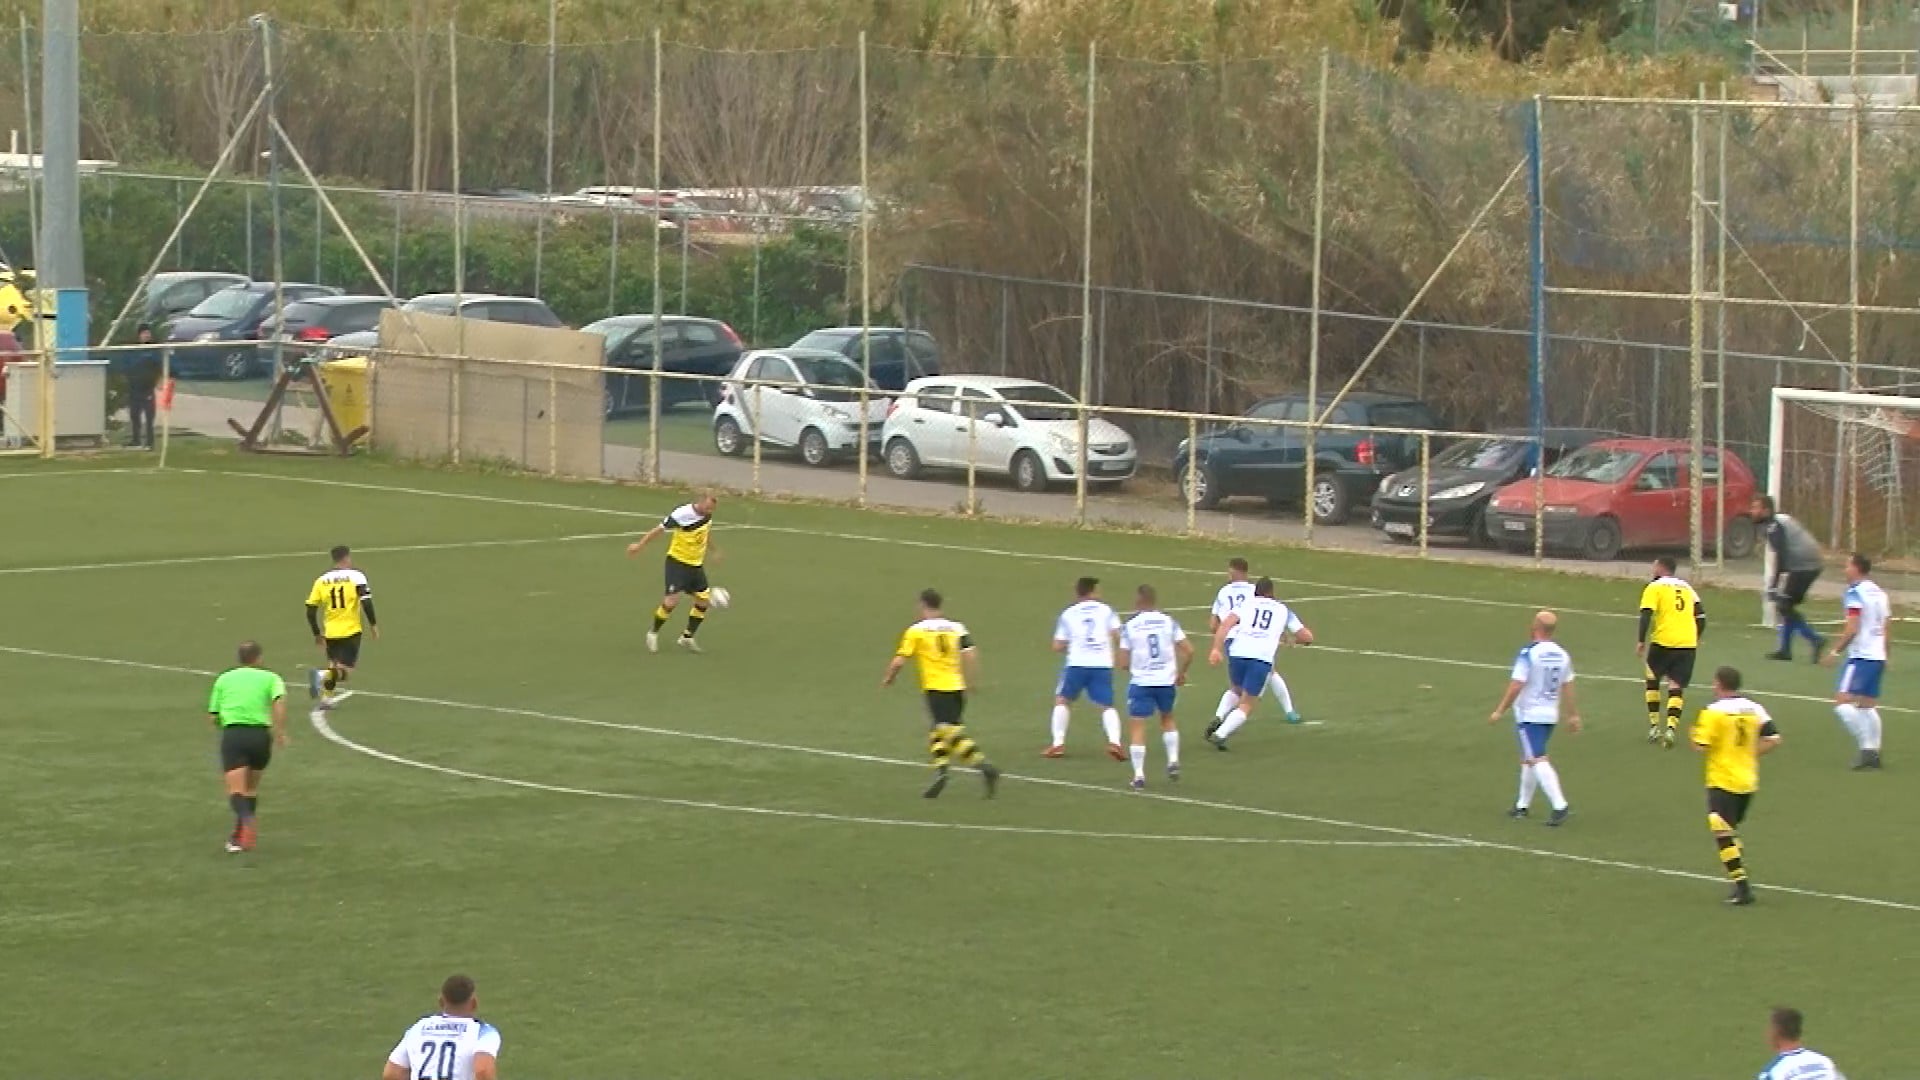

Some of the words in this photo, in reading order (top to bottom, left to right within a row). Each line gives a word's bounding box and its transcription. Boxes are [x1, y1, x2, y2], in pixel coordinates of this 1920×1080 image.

[330, 585, 346, 609] 11
[1675, 589, 1685, 612] 5
[1252, 607, 1273, 630] 19
[1147, 633, 1160, 659] 8
[418, 1041, 457, 1080] 20
